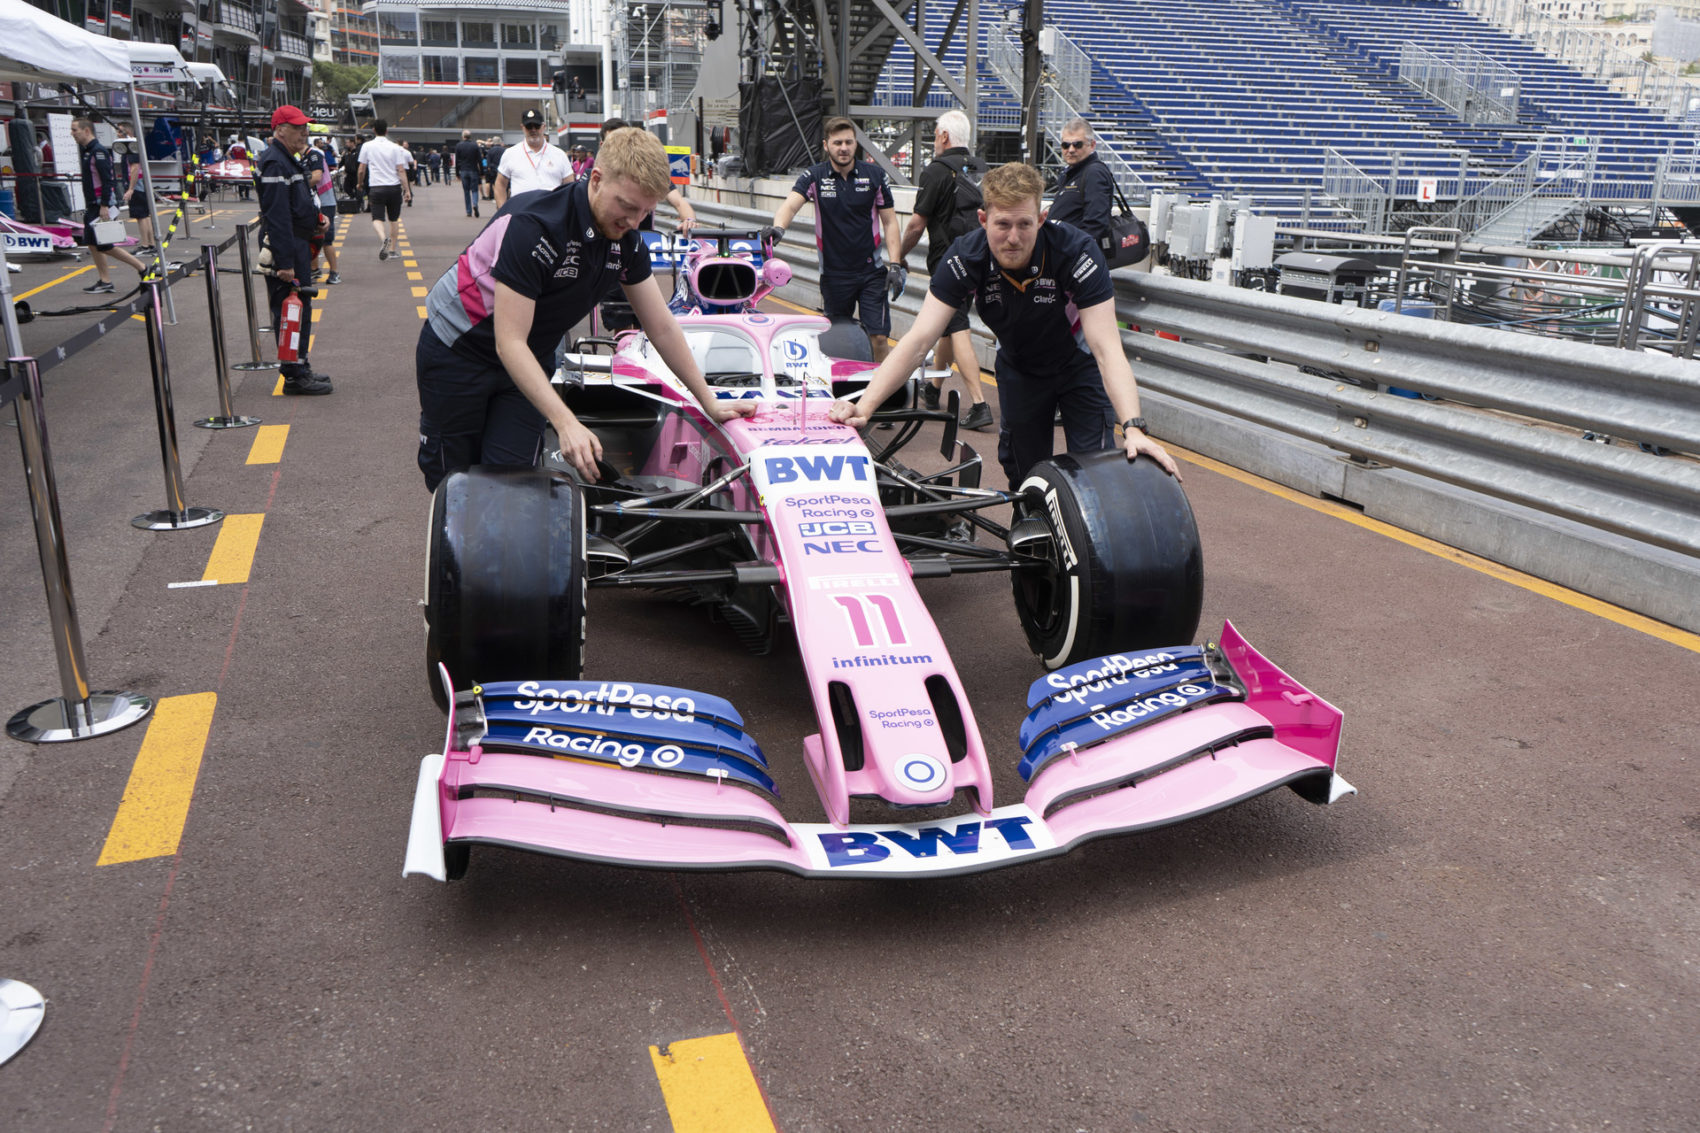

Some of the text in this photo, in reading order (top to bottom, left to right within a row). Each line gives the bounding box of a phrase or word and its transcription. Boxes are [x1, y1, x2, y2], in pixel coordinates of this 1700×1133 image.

[1422, 186, 1431, 200] L
[18, 237, 50, 248] BWT
[760, 436, 857, 447] telcel
[765, 455, 869, 485] BWT
[785, 494, 871, 509] SportPesa
[803, 508, 858, 519] Racing
[799, 521, 876, 537] JCB
[804, 540, 883, 555] NEC
[827, 591, 912, 650] 11
[832, 653, 933, 669] infinitum
[1047, 651, 1177, 705] SportPesa
[513, 680, 695, 723] SportPesa
[869, 708, 931, 720] SportPesa
[1088, 692, 1186, 730] Racing
[882, 719, 922, 729] Racing
[522, 727, 645, 768] Racing
[816, 815, 1037, 868] BWT
